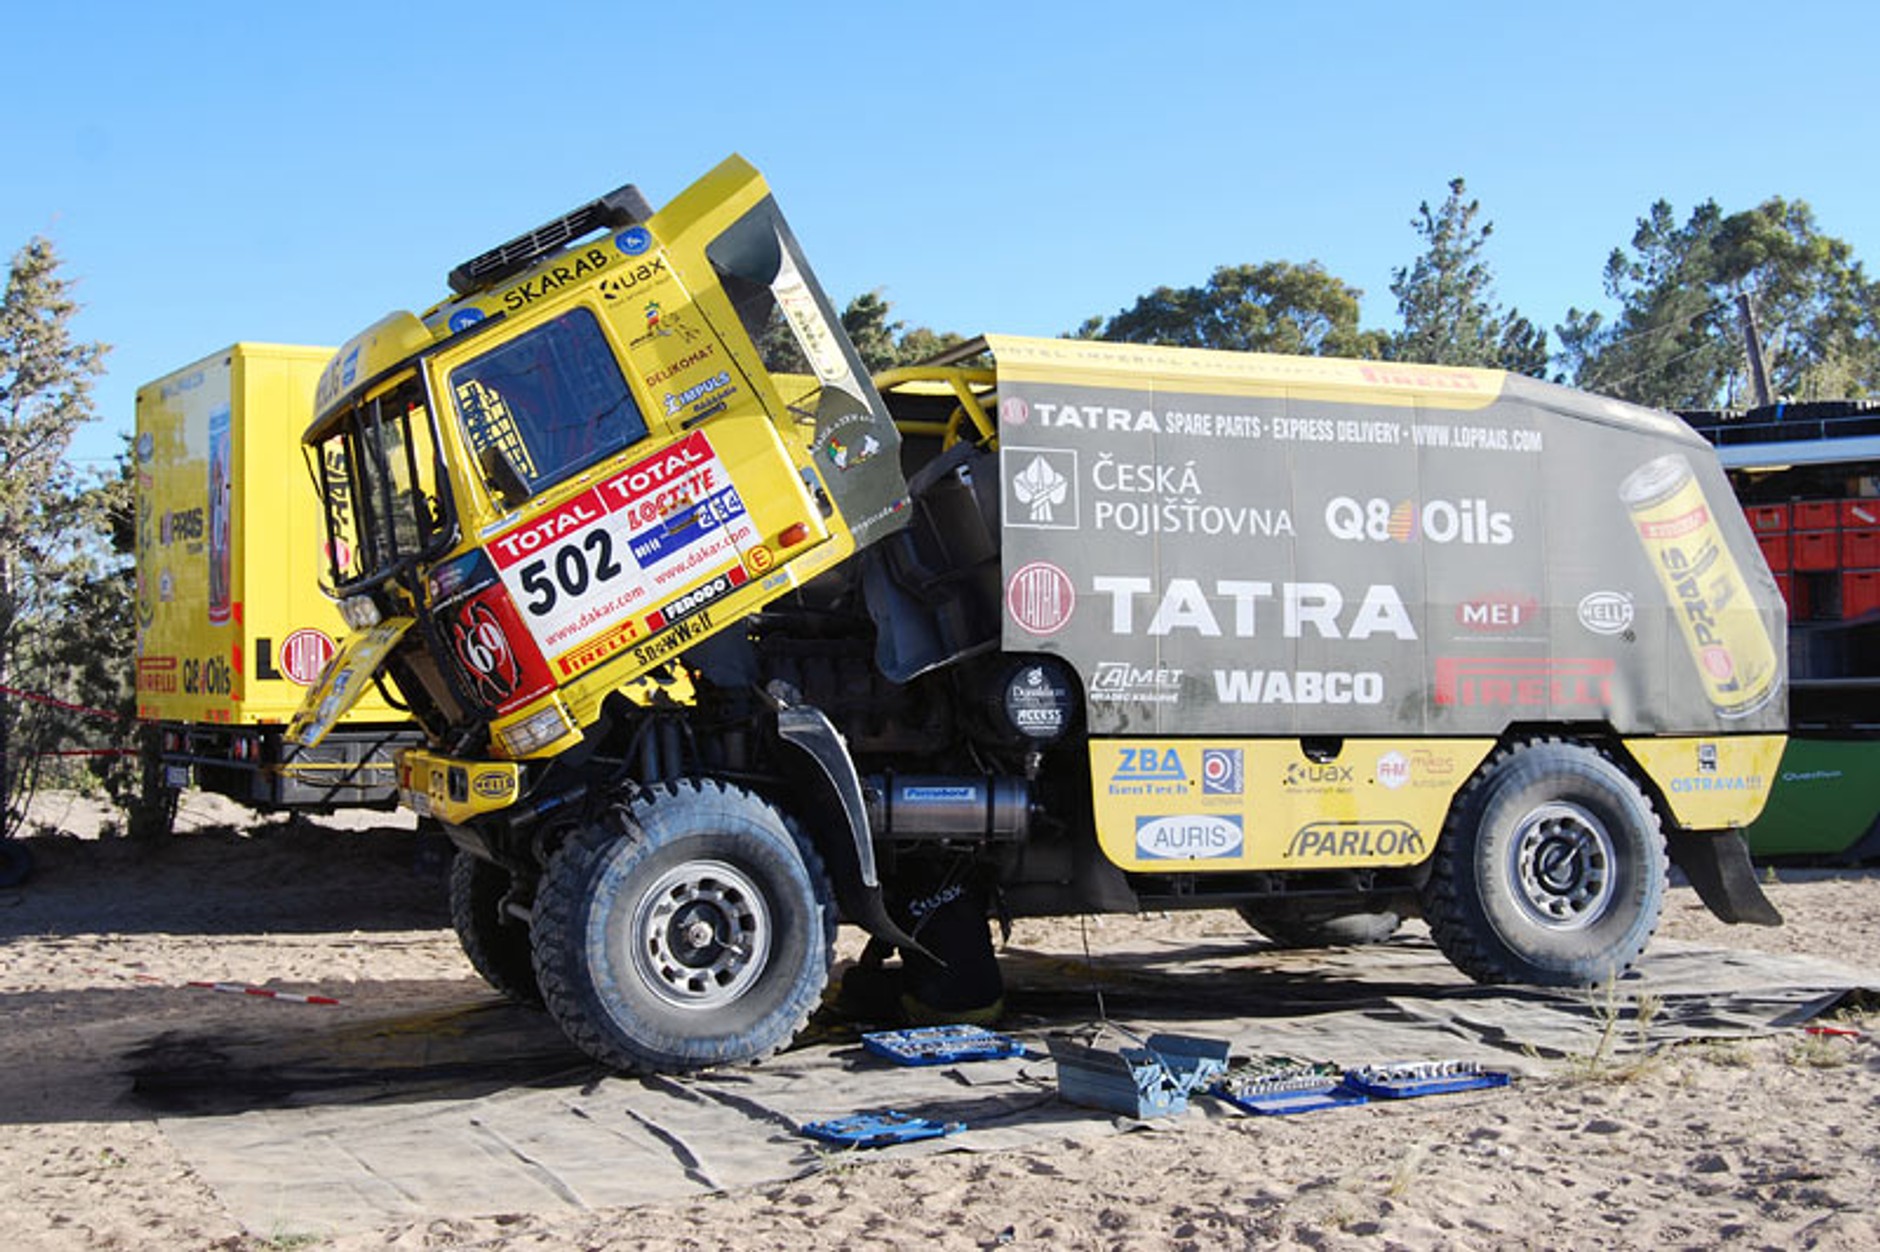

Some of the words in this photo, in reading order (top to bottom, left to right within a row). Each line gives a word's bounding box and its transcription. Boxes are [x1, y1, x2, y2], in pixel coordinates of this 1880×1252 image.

[504, 249, 608, 312] SKARAB
[680, 372, 731, 404] IMPULS
[1034, 403, 1162, 433] TATRA
[1166, 411, 1211, 437] SPARE
[1215, 415, 1261, 438] PARTS
[1272, 417, 1334, 442] EXPRESS
[1336, 420, 1401, 444] DELIVERY
[1412, 425, 1543, 452] WWW.LOPRAIS.COM
[609, 448, 703, 499] TOTAL
[1092, 451, 1201, 495] ČESKÁ
[626, 468, 714, 531] LOCTITE
[1095, 498, 1297, 537] POJIŠŤOVNA
[1325, 497, 1391, 541] Q8
[1421, 499, 1514, 544] Oils
[499, 504, 596, 556] TOTAL
[520, 528, 622, 616] 502
[654, 525, 751, 584] www.dakar.com
[547, 585, 646, 645] www.dakar.com
[666, 579, 726, 620] FERODO
[1020, 568, 1061, 628] TATRA
[1092, 576, 1418, 641] TATRA
[1462, 604, 1521, 625] MEI
[1580, 602, 1635, 621] HELLA
[468, 621, 505, 674] 69
[558, 619, 637, 676] PIRELLI
[1214, 668, 1384, 704] WABCO
[1435, 658, 1615, 706] PIRELLI
[1017, 709, 1063, 723] ACCESS
[1113, 748, 1186, 779] ZBA
[1670, 776, 1761, 792] OSTRAVA!!!
[1154, 826, 1226, 848] AURIS
[1297, 830, 1423, 858] PARLOK
